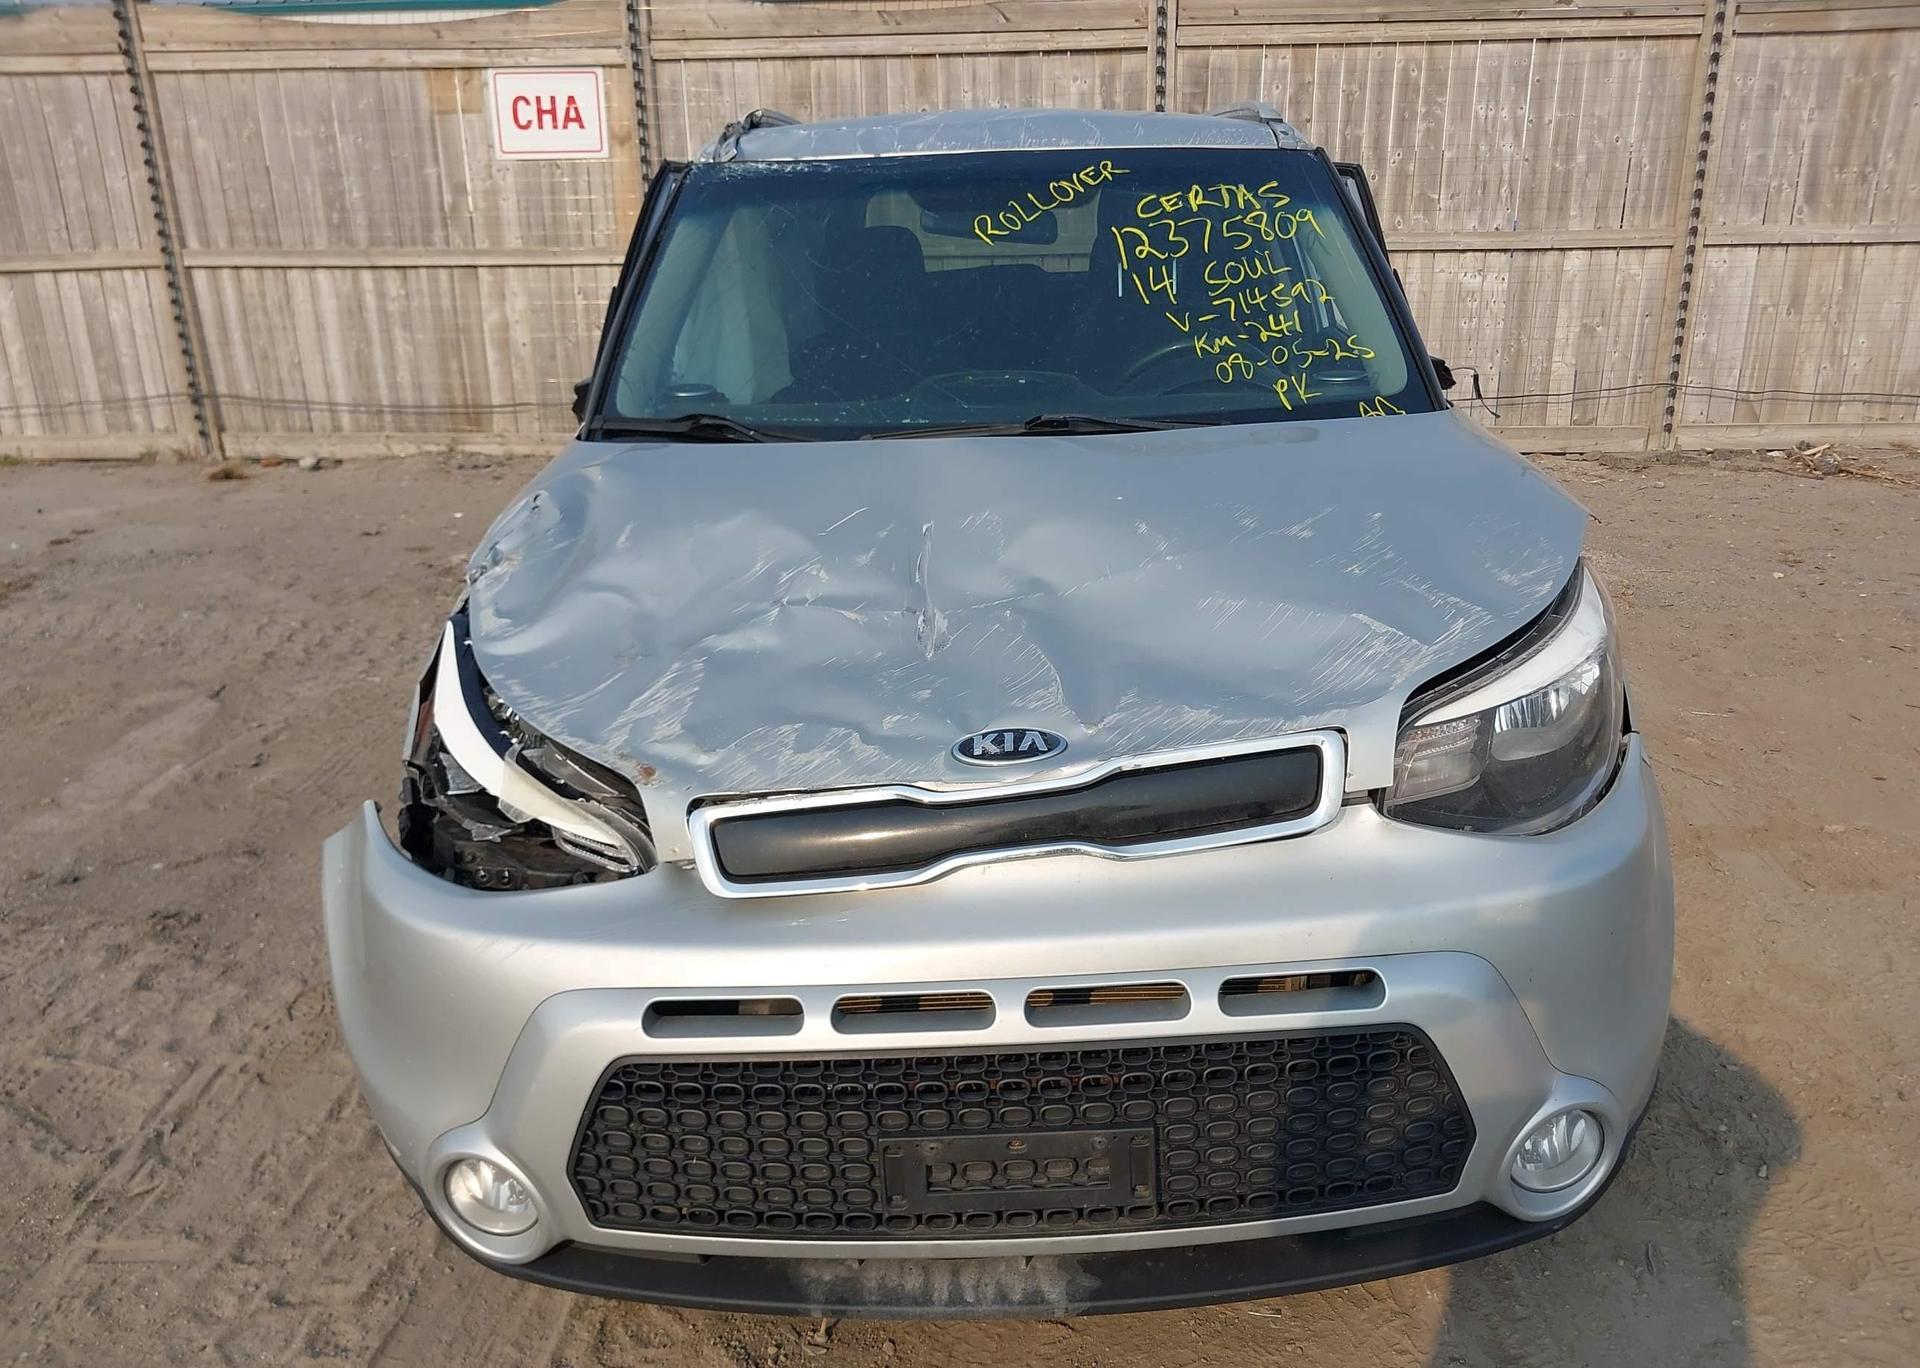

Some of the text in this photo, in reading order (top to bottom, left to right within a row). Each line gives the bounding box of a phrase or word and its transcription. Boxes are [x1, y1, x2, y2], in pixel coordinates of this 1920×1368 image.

[512, 95, 585, 130] CHA
[973, 160, 1130, 245] ROLLOVER
[1136, 181, 1290, 219] CERTAS
[1112, 208, 1326, 270] 12375809
[1132, 250, 1292, 305] 14 SOUL
[972, 731, 1048, 756] KIA
